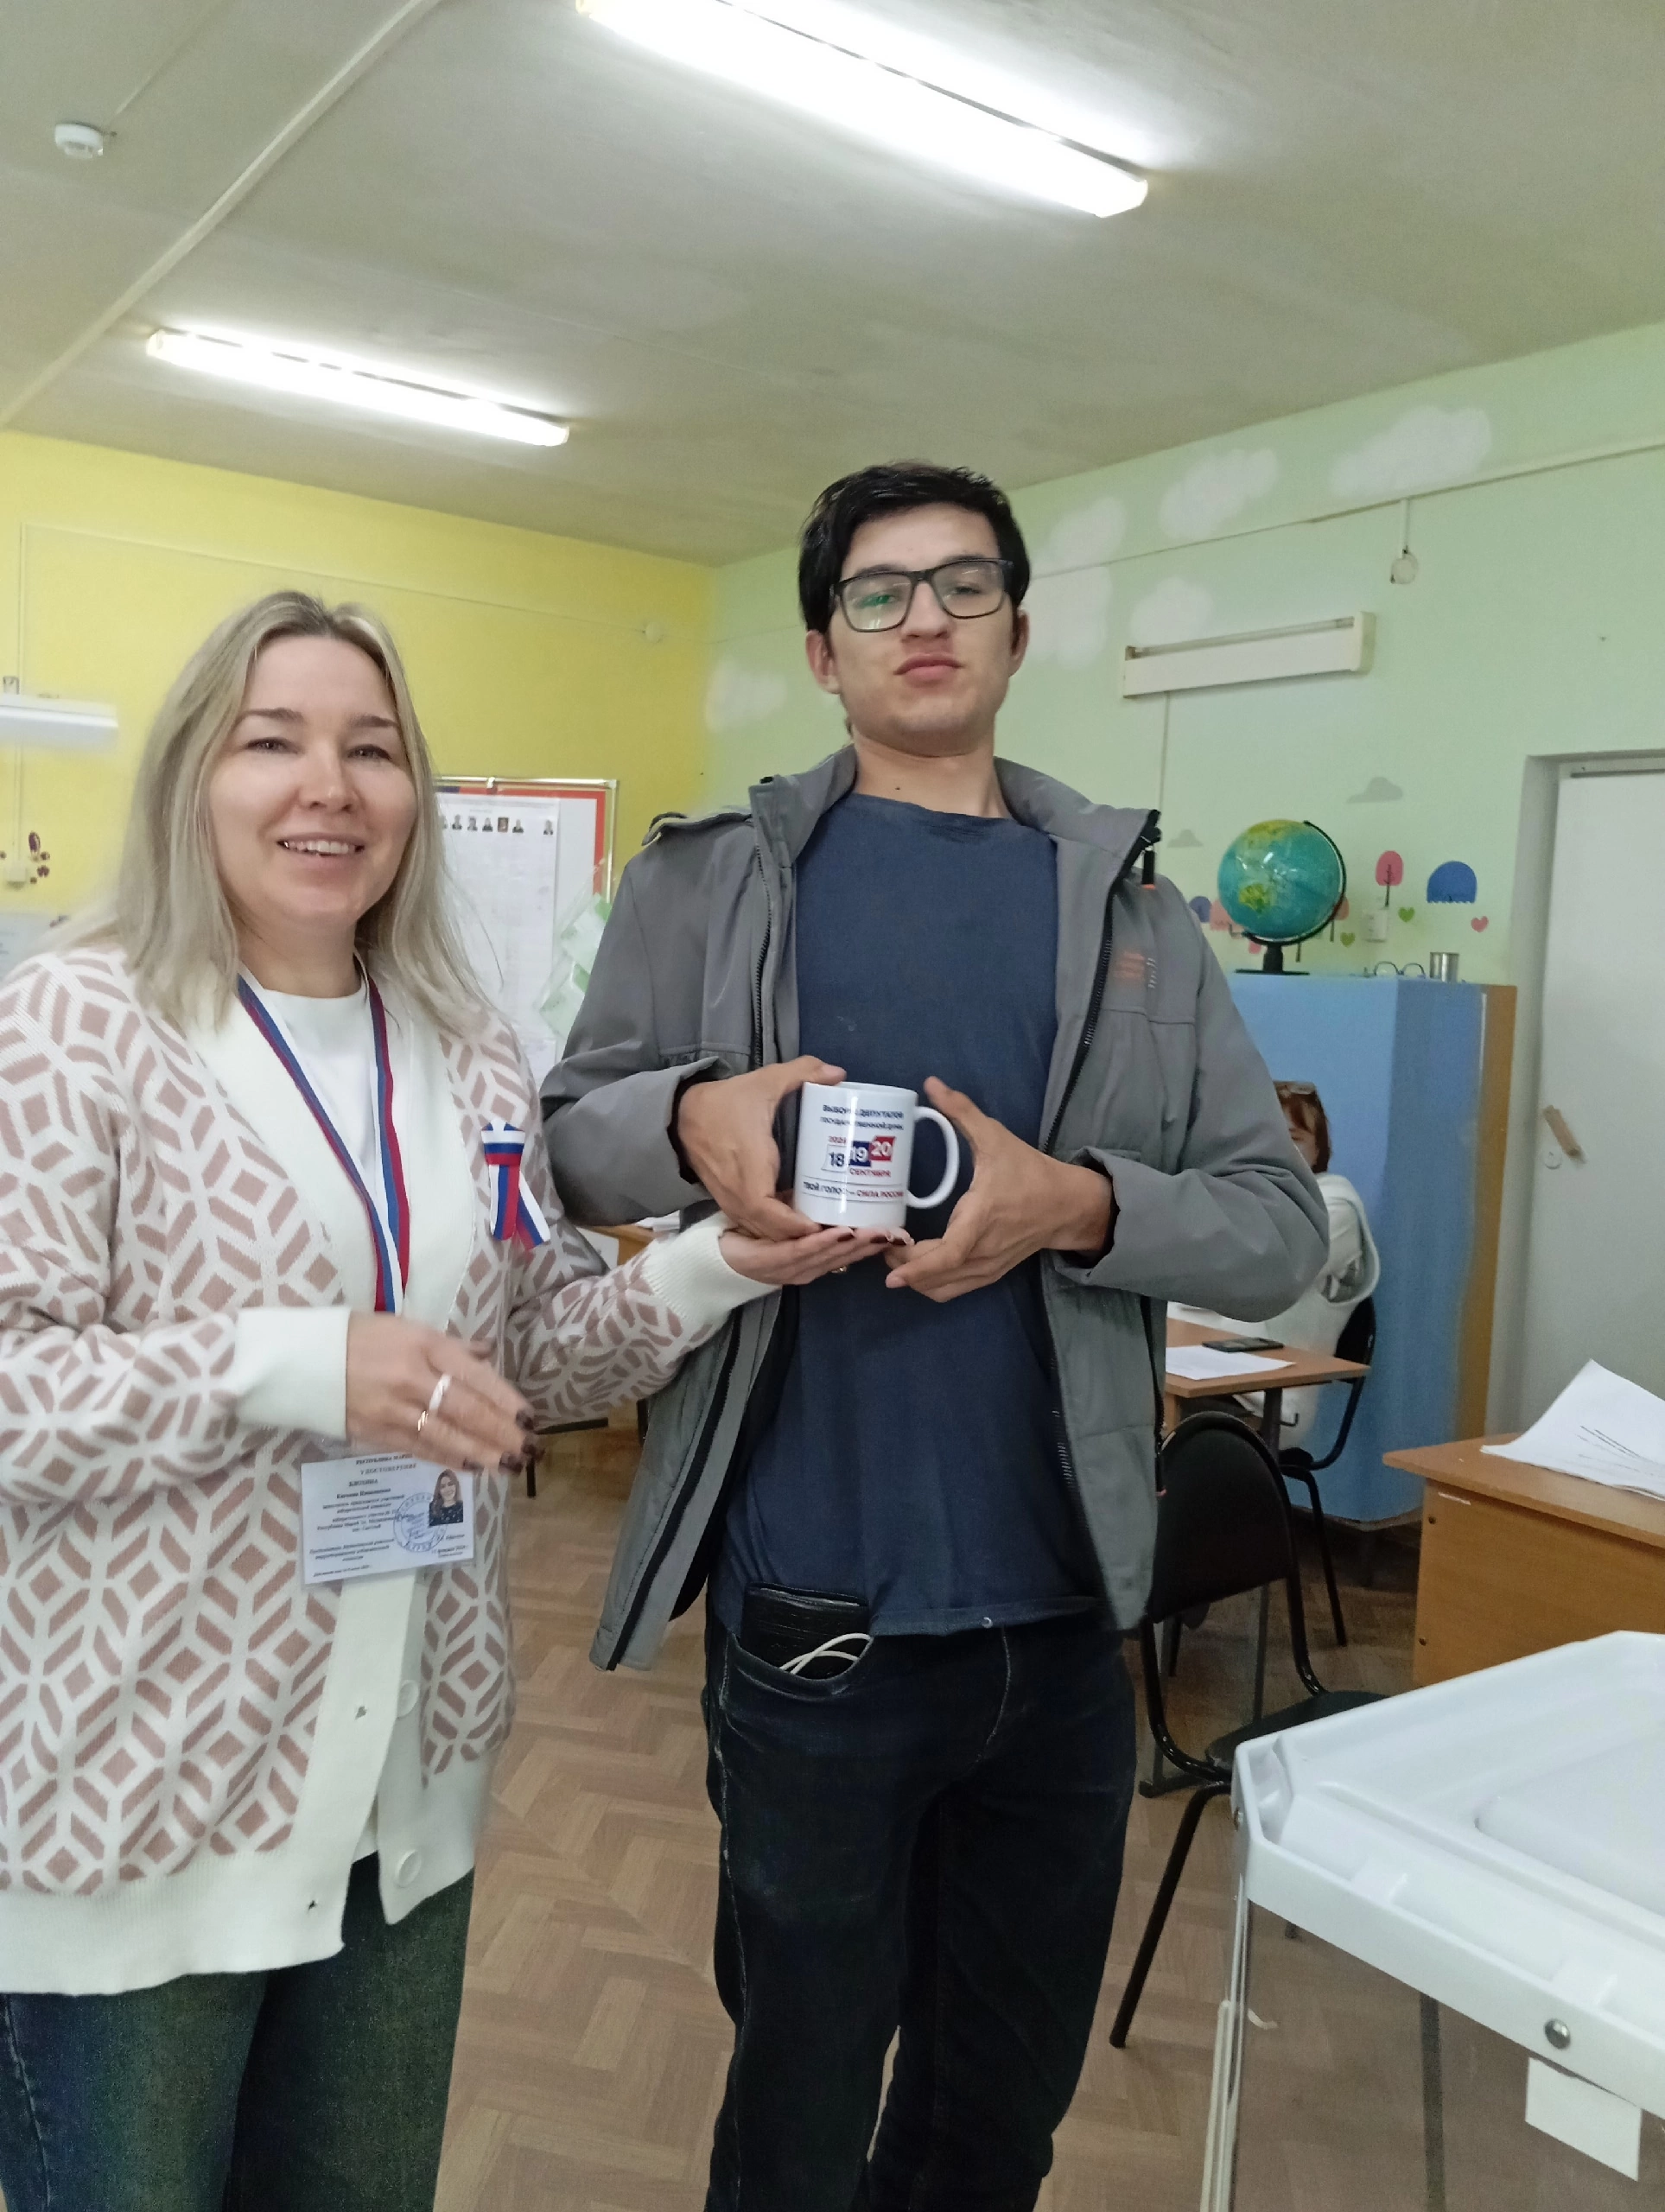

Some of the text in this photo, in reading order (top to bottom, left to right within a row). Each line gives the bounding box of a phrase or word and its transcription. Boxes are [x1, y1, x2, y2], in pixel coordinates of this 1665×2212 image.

[823, 1104, 856, 1116] ВЫБОР
[850, 1146, 868, 1163] 19
[871, 1141, 892, 1157] 20
[829, 1151, 845, 1167] 18
[821, 1185, 846, 1195] ГОЛО
